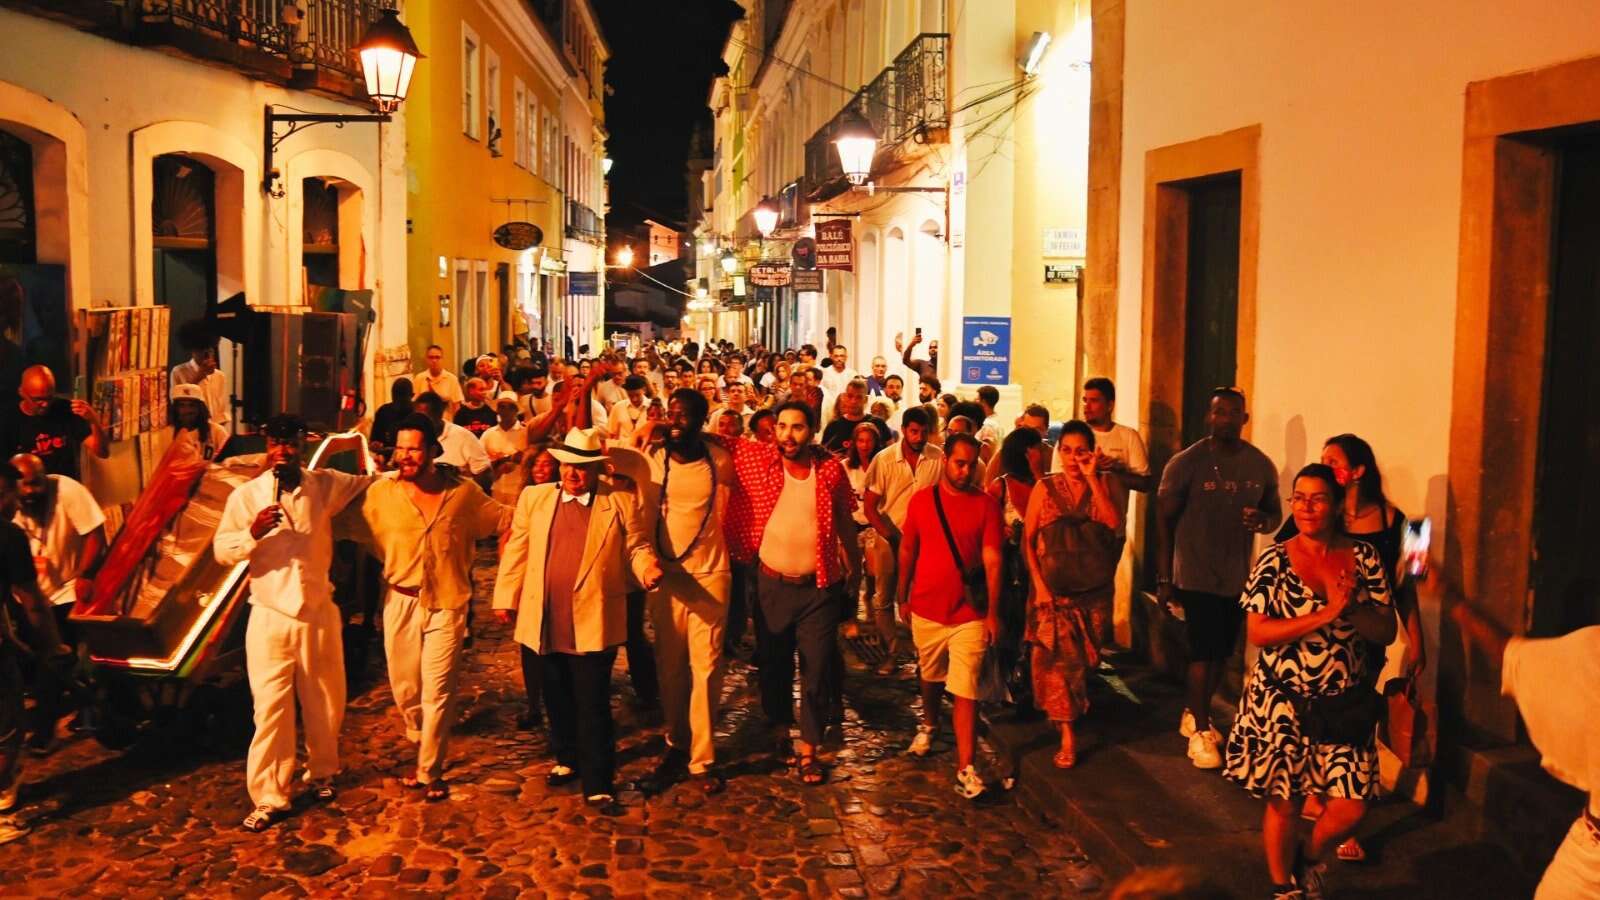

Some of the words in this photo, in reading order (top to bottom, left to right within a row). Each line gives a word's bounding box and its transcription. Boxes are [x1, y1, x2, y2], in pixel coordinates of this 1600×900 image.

[821, 229, 844, 240] BALÉ
[828, 254, 850, 264] BAHIA
[976, 348, 996, 356] ÁREA
